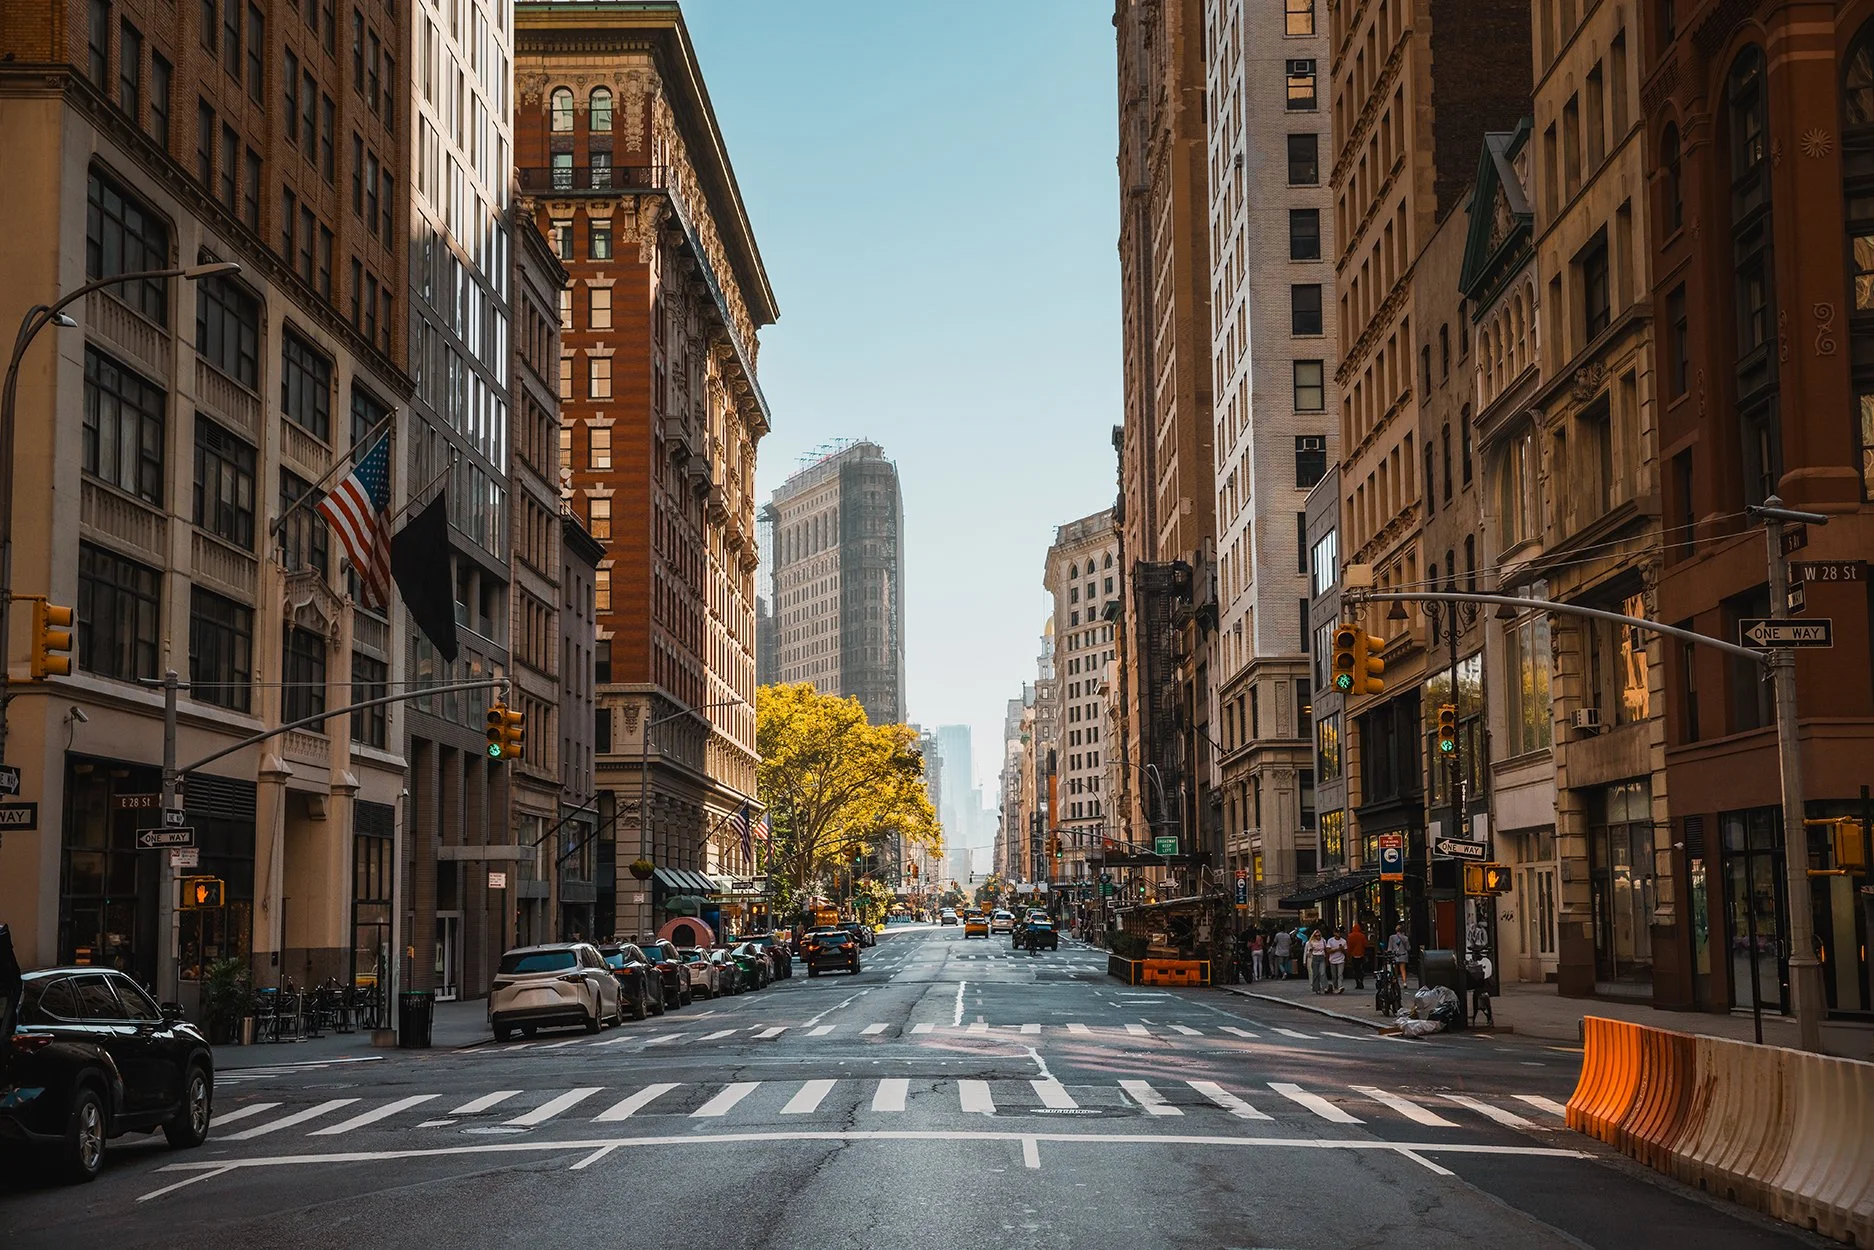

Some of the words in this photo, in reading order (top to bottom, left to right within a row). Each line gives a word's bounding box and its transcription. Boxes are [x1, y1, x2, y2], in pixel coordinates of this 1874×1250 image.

[1804, 567, 1816, 580] W
[1822, 566, 1838, 580] 28
[1843, 565, 1857, 580] St
[1754, 628, 1780, 639] ONE
[1792, 627, 1820, 639] WAY
[122, 798, 126, 808] E
[129, 797, 139, 807] 28
[142, 797, 151, 807] St
[0, 811, 25, 823] WAY
[145, 834, 161, 843] ONE
[168, 833, 187, 842] WAY
[1442, 842, 1457, 852] ONE
[1463, 845, 1480, 854] WAY
